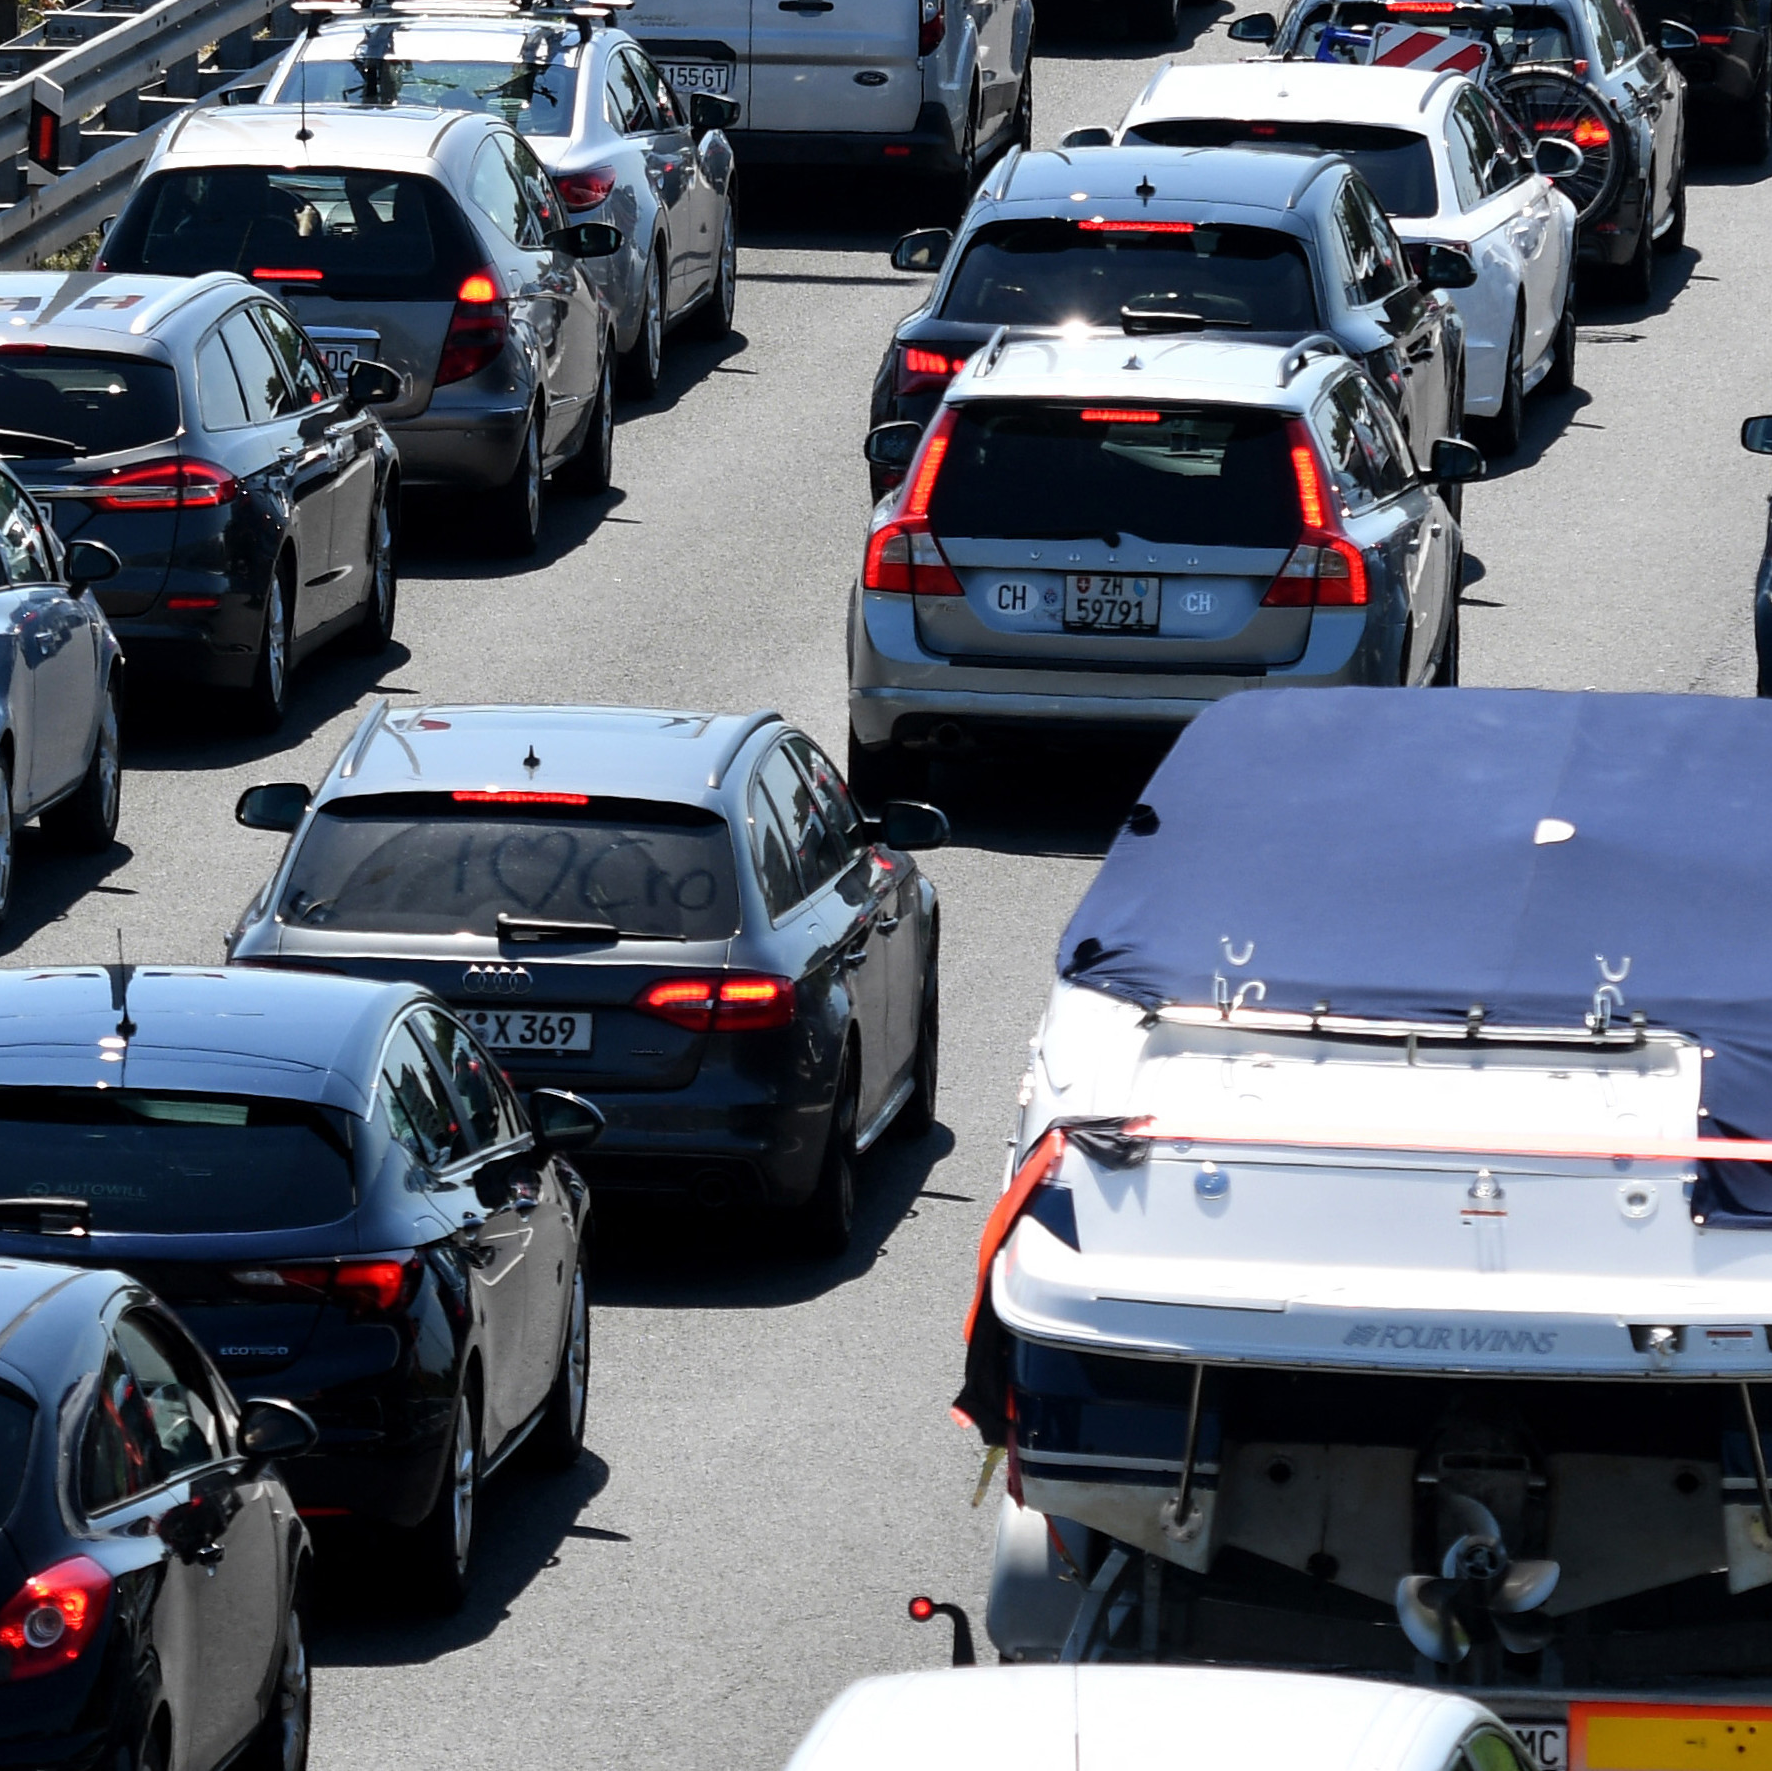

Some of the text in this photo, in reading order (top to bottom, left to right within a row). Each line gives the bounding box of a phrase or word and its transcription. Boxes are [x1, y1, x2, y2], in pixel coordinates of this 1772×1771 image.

[1101, 578, 1123, 596] ZH
[998, 584, 1211, 625] CH 59791 CH
[493, 1015, 576, 1046] X 369
[55, 1182, 148, 1198] AUTOWILL
[1377, 1325, 1558, 1354] FOUR WINNS
